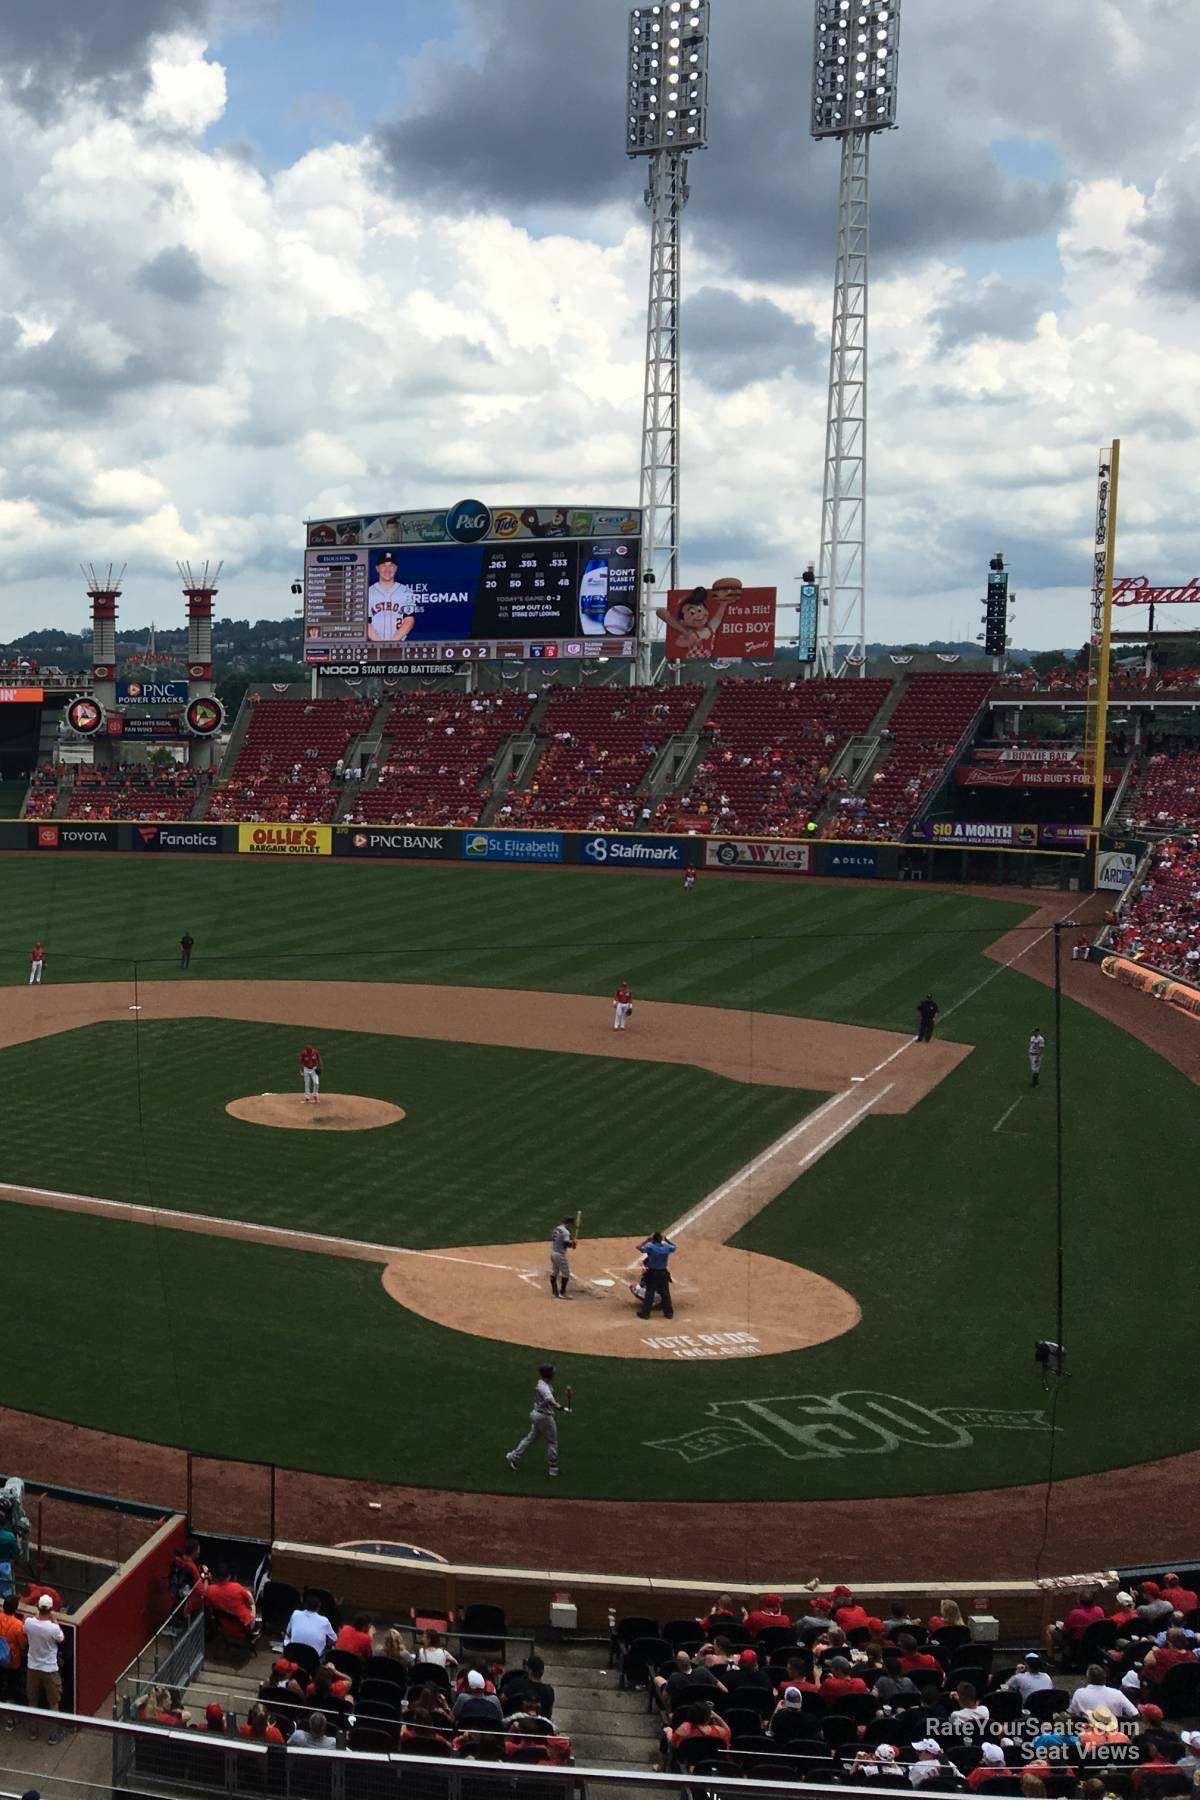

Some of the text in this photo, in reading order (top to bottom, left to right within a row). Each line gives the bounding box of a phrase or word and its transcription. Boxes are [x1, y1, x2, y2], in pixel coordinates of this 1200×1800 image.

[456, 514, 486, 529] P&G
[494, 516, 519, 534] Tide
[518, 560, 537, 568] .393
[549, 559, 567, 567] .533
[610, 569, 635, 577] DON'T
[371, 602, 404, 616] ASTROS
[728, 605, 770, 615] It's Hit!
[722, 622, 770, 633] BIG BOY
[320, 666, 359, 675] NOCO
[361, 666, 385, 674] START
[387, 666, 408, 674] DEAD
[143, 684, 175, 696] PNC
[1013, 751, 1067, 761] BOWTIE BAR
[1022, 774, 1041, 782] THIS
[1044, 774, 1071, 783] BUD'S
[62, 831, 107, 841] TOYOTA
[253, 828, 317, 845] OLLIE'S
[955, 825, 962, 836] A
[965, 825, 1012, 838] MONTH
[160, 831, 217, 846] Fanatics
[370, 835, 443, 849] PNC BANK
[250, 845, 287, 853] BARGAIN
[505, 840, 560, 853] Elizabeth
[610, 844, 679, 860] Staffmark
[747, 844, 806, 864] Wyler
[843, 857, 874, 865] DELTA
[640, 1336, 701, 1349] VOTE
